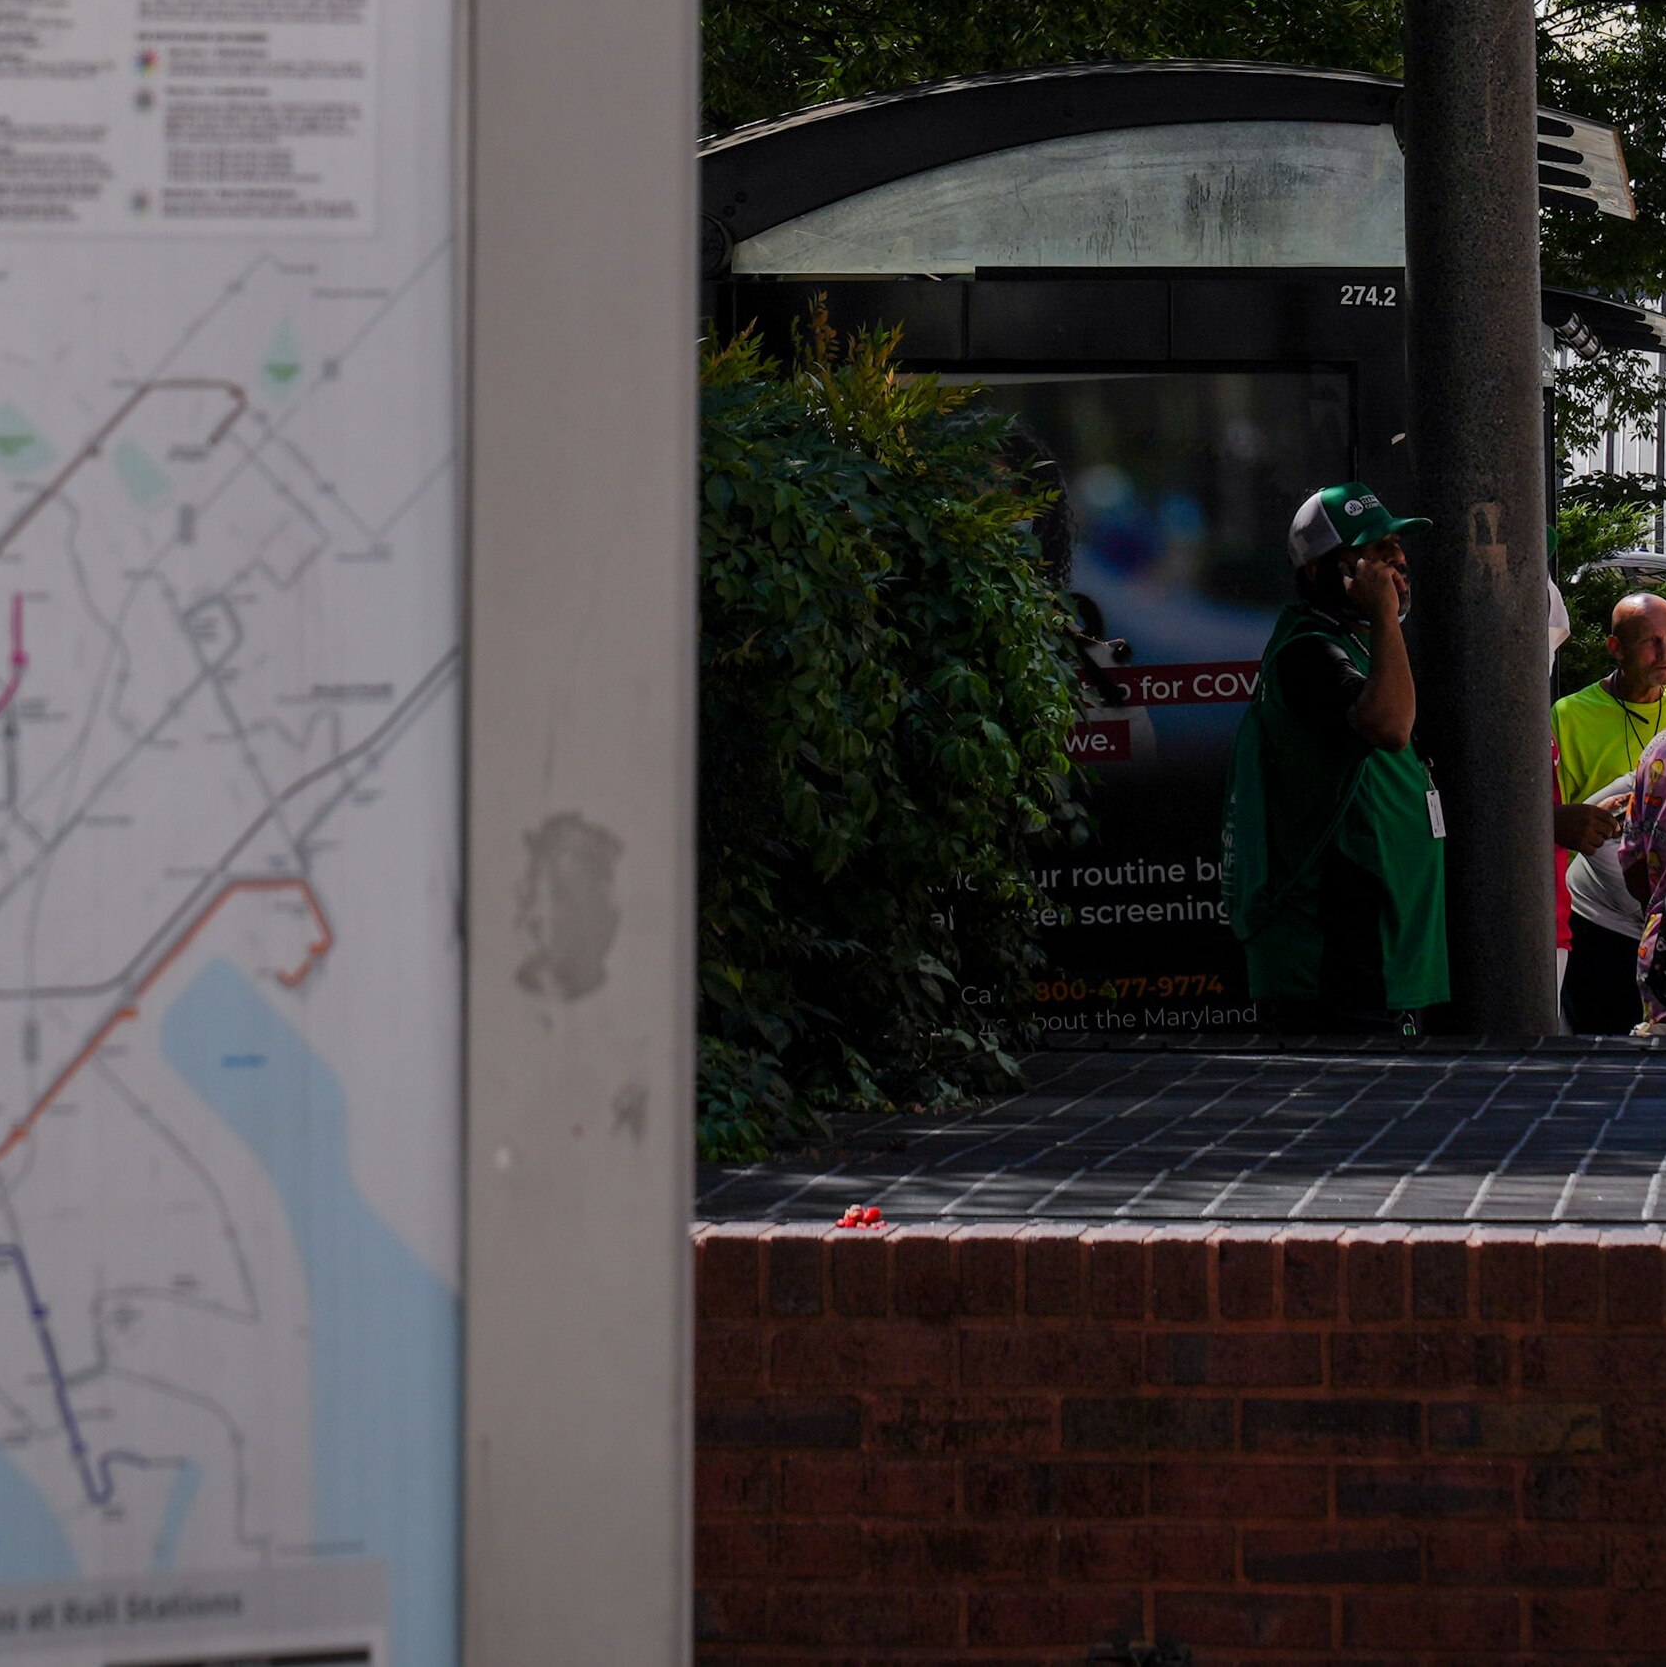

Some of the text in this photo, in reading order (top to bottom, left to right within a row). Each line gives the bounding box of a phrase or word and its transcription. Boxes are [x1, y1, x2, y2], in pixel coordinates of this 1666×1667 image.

[1340, 285, 1397, 307] 274.2
[1139, 675, 1183, 701] for
[1193, 671, 1260, 698] COV
[1072, 857, 1186, 887] routine
[1032, 1003, 1258, 1032] bout the Maryland
[63, 1594, 121, 1630] Rail
[126, 1587, 245, 1626] Stations
